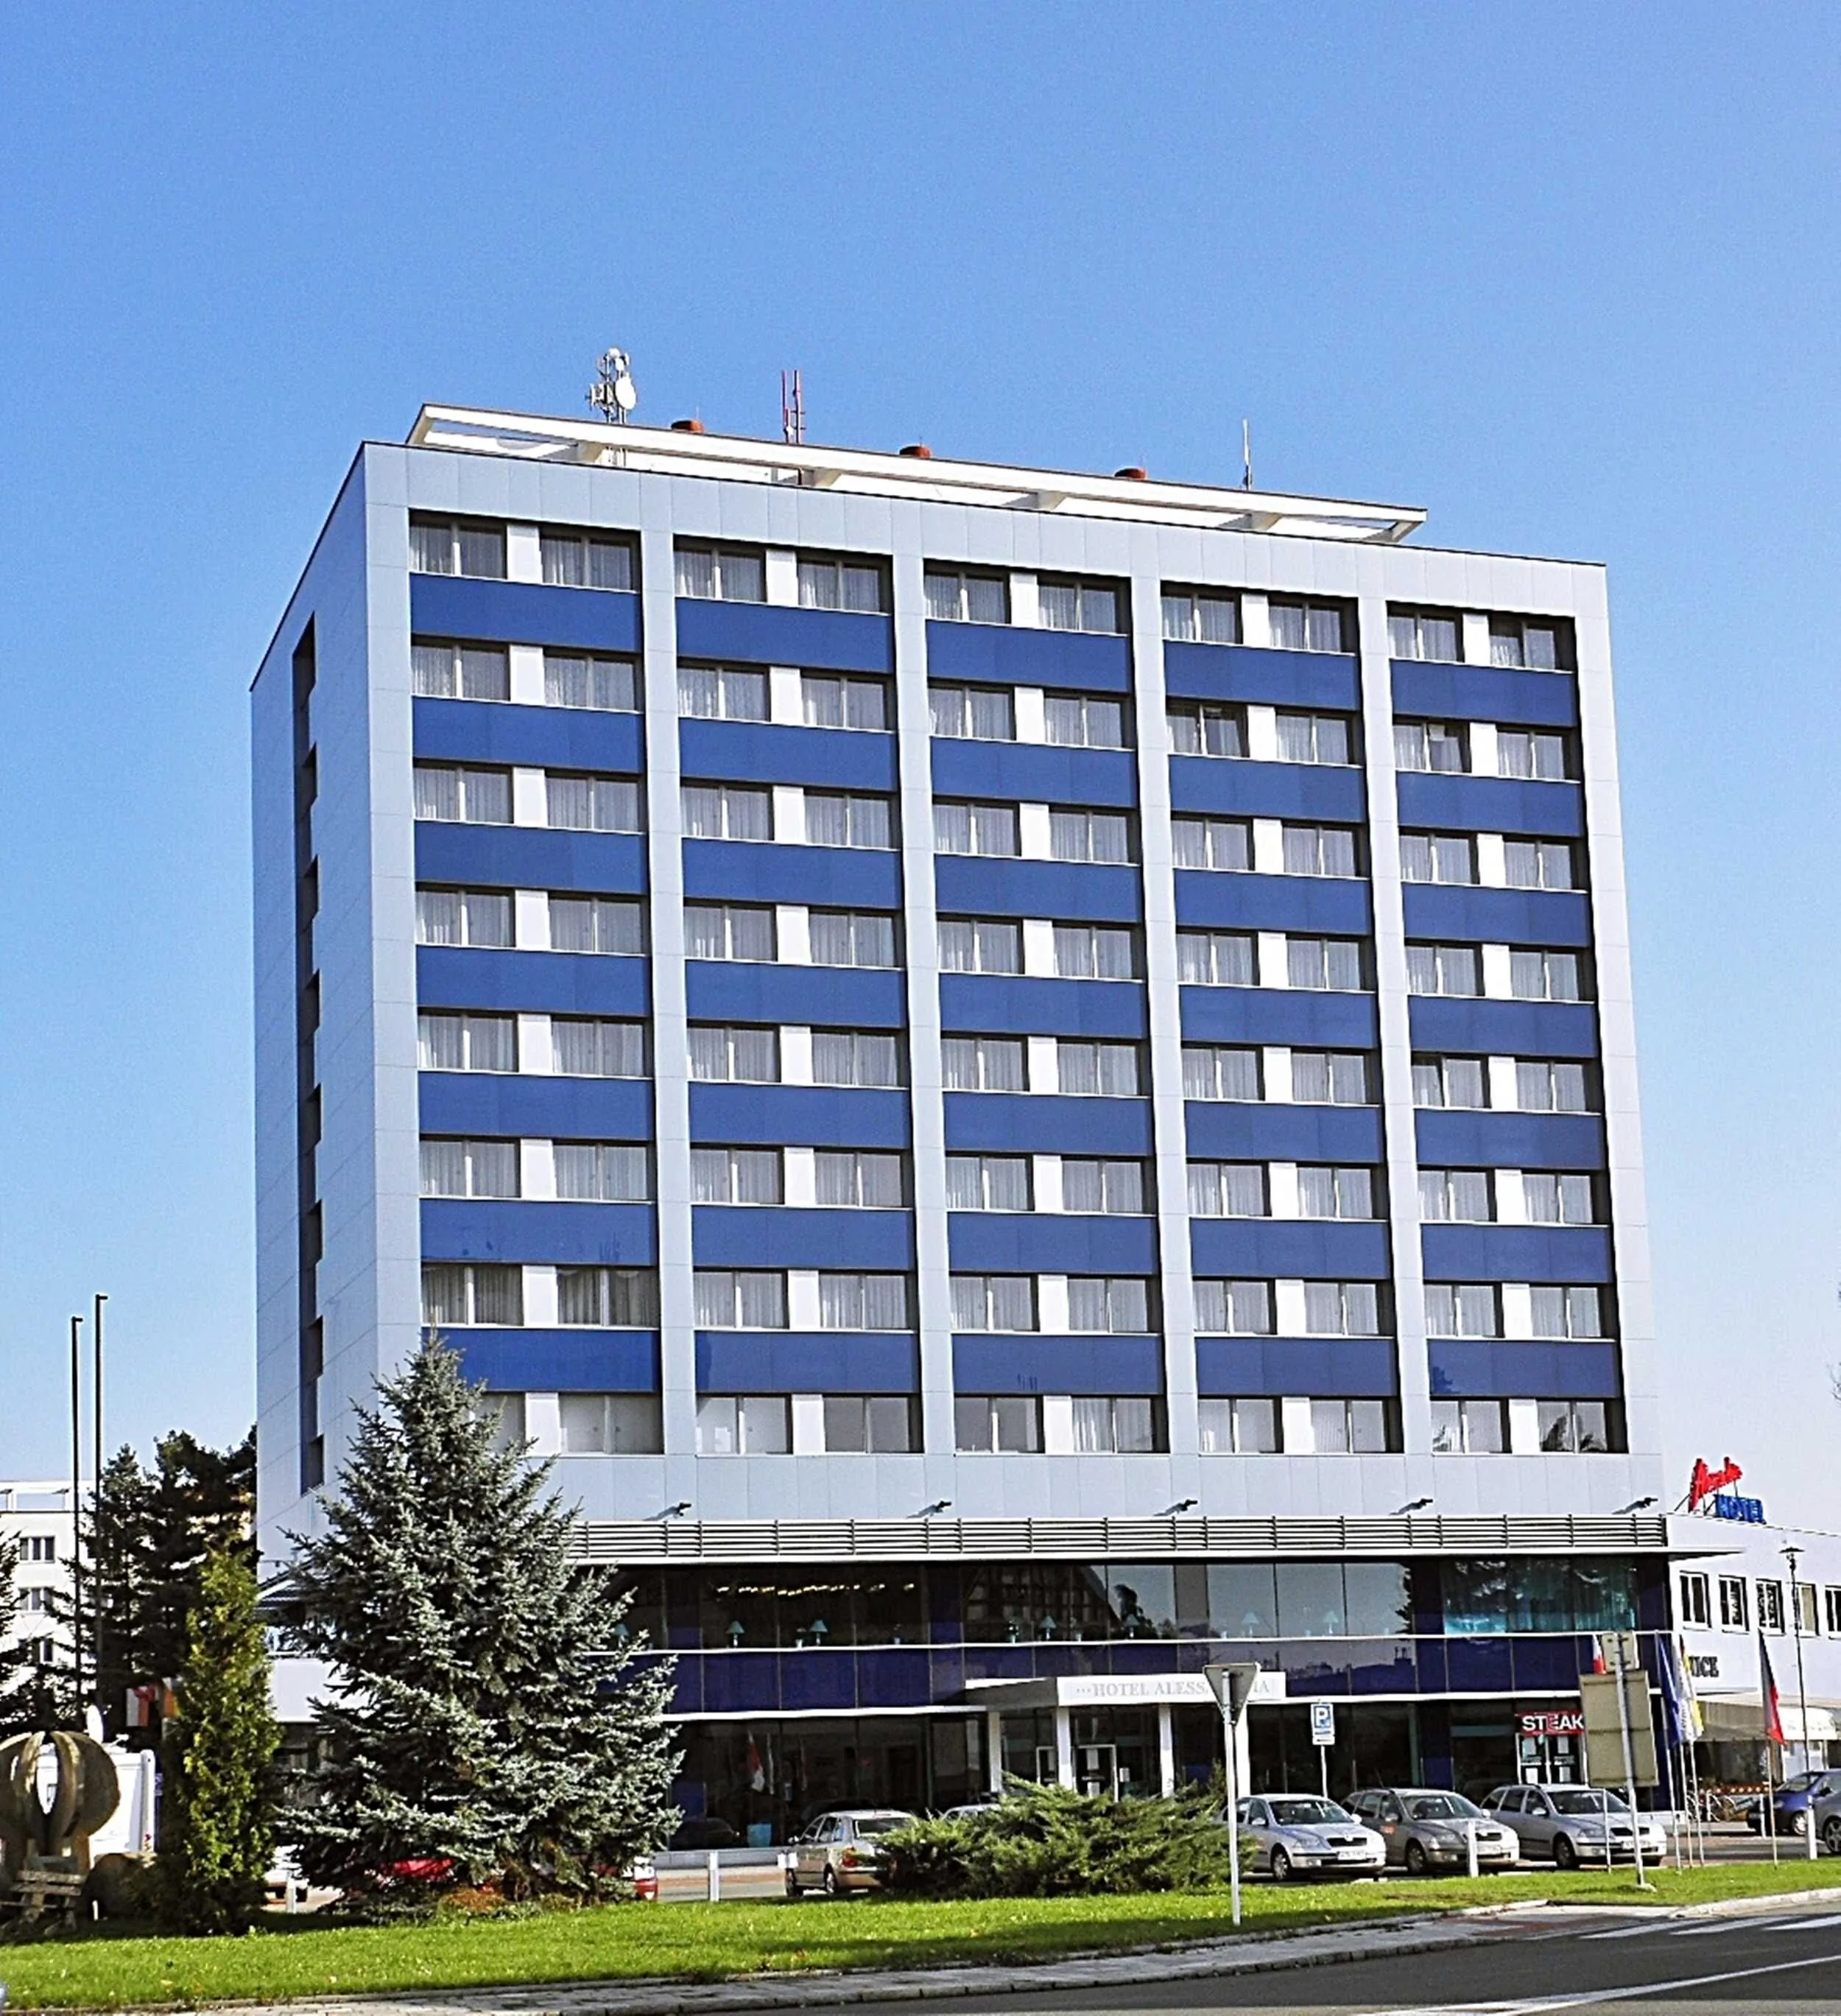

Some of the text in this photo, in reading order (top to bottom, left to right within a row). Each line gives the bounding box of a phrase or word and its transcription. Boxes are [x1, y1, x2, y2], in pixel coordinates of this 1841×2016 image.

[1092, 1679, 1270, 1697] HOTEL ALESSIA
[1315, 1707, 1328, 1726] P
[1521, 1713, 1585, 1731] STEAK
